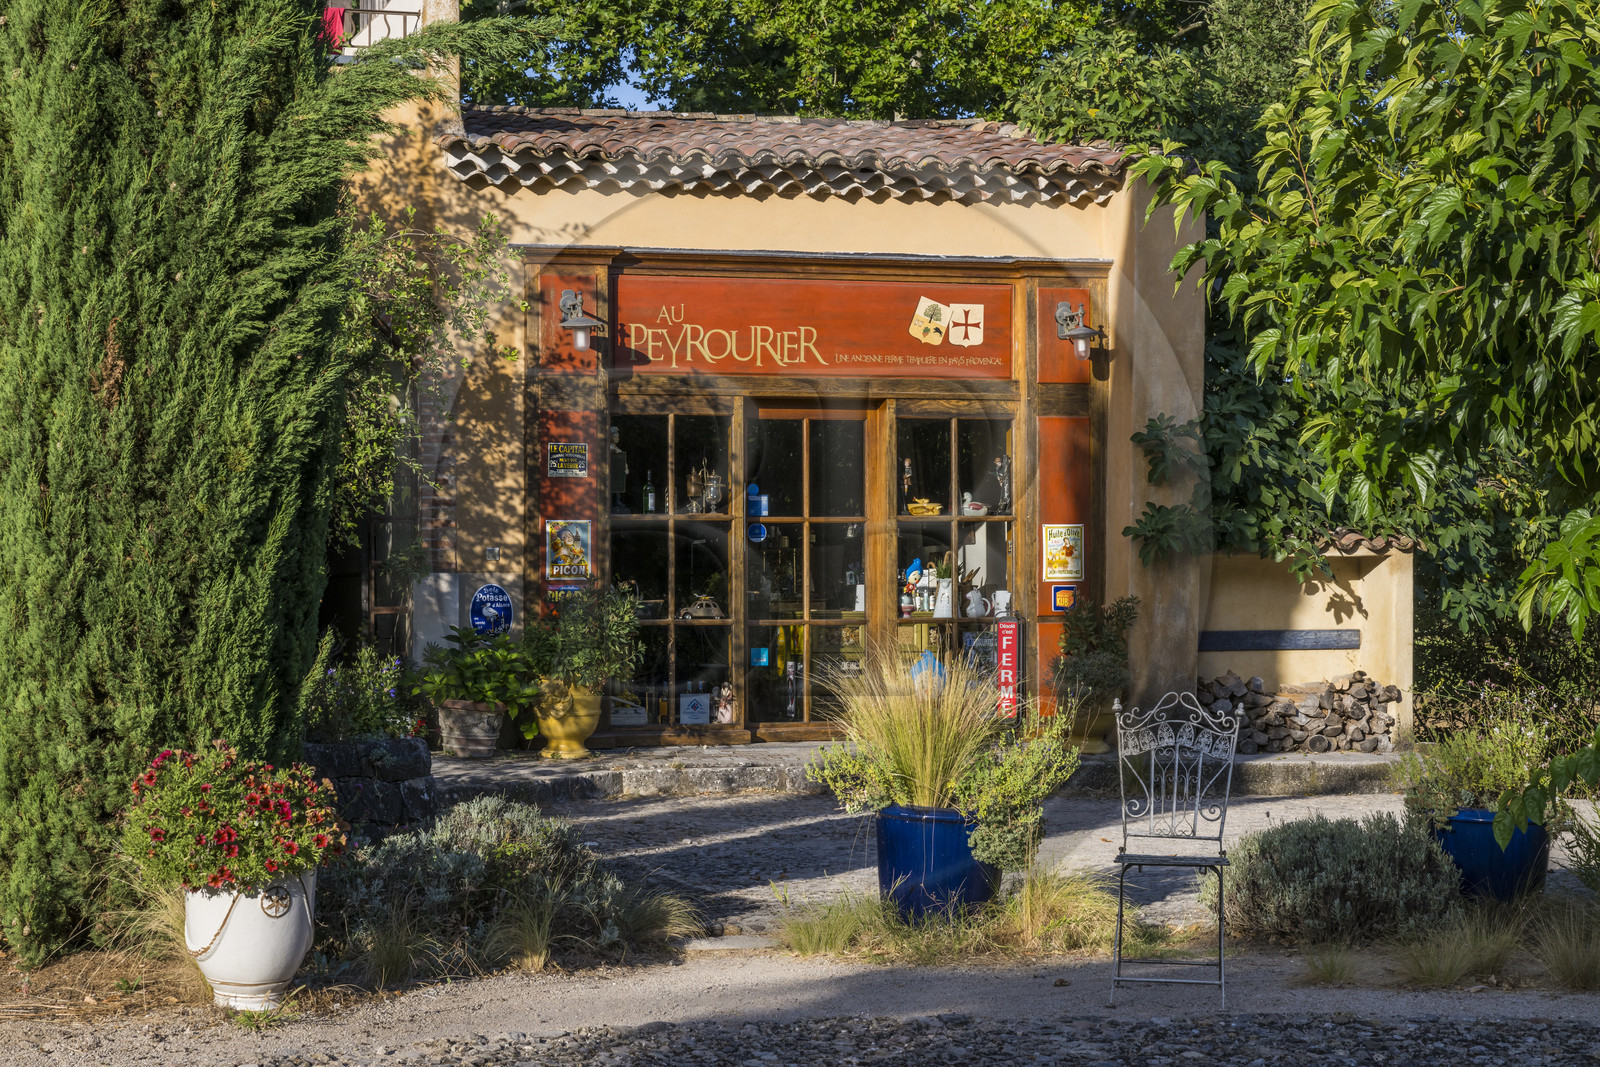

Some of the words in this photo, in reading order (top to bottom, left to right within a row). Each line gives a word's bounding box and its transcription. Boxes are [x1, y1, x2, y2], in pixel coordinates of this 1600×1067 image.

[656, 303, 685, 325] AU
[628, 323, 829, 368] PEYROURIER
[851, 354, 886, 363] ANCIENNE
[885, 355, 904, 364] FERME
[939, 356, 948, 365] EN
[550, 445, 558, 453] LE
[558, 445, 587, 454] CAPITAL
[553, 565, 586, 575] PICON
[475, 592, 508, 602] Potasse
[1056, 597, 1069, 607] KUB
[1000, 636, 1013, 717] FERMÉ
